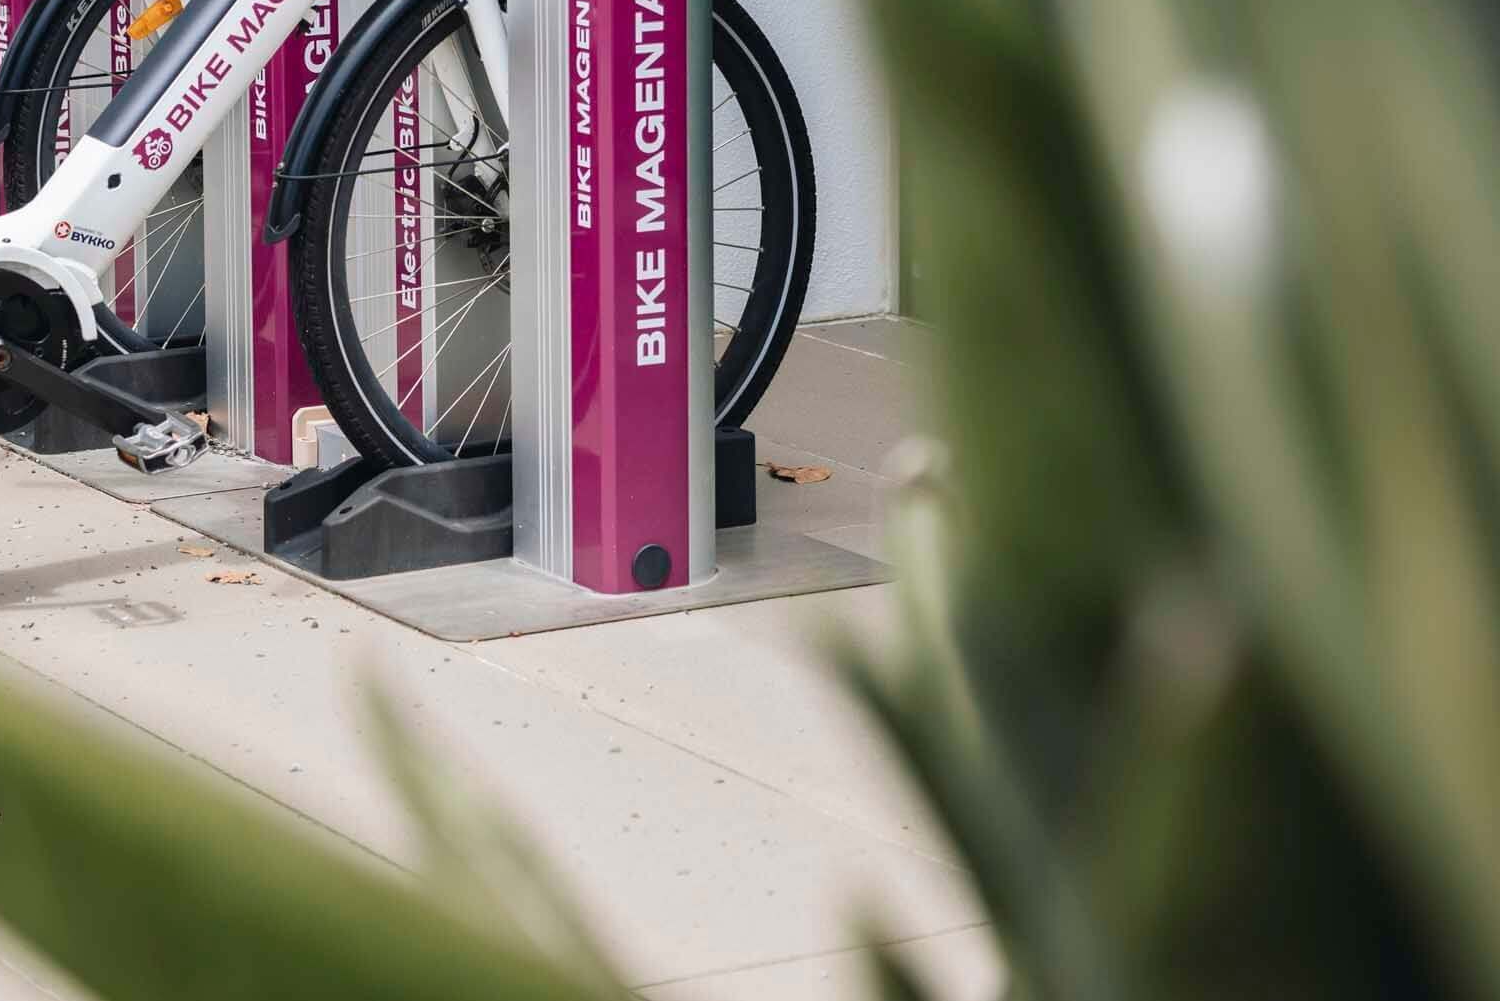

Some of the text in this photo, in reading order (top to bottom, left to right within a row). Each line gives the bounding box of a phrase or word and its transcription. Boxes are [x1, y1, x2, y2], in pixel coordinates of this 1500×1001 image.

[166, 54, 232, 132] BIKE
[255, 68, 267, 139] BIKE
[399, 74, 417, 308] Electric Bike
[576, 146, 592, 229] BIKE
[71, 231, 116, 250] BYKKO
[636, 248, 666, 367] BIKE
